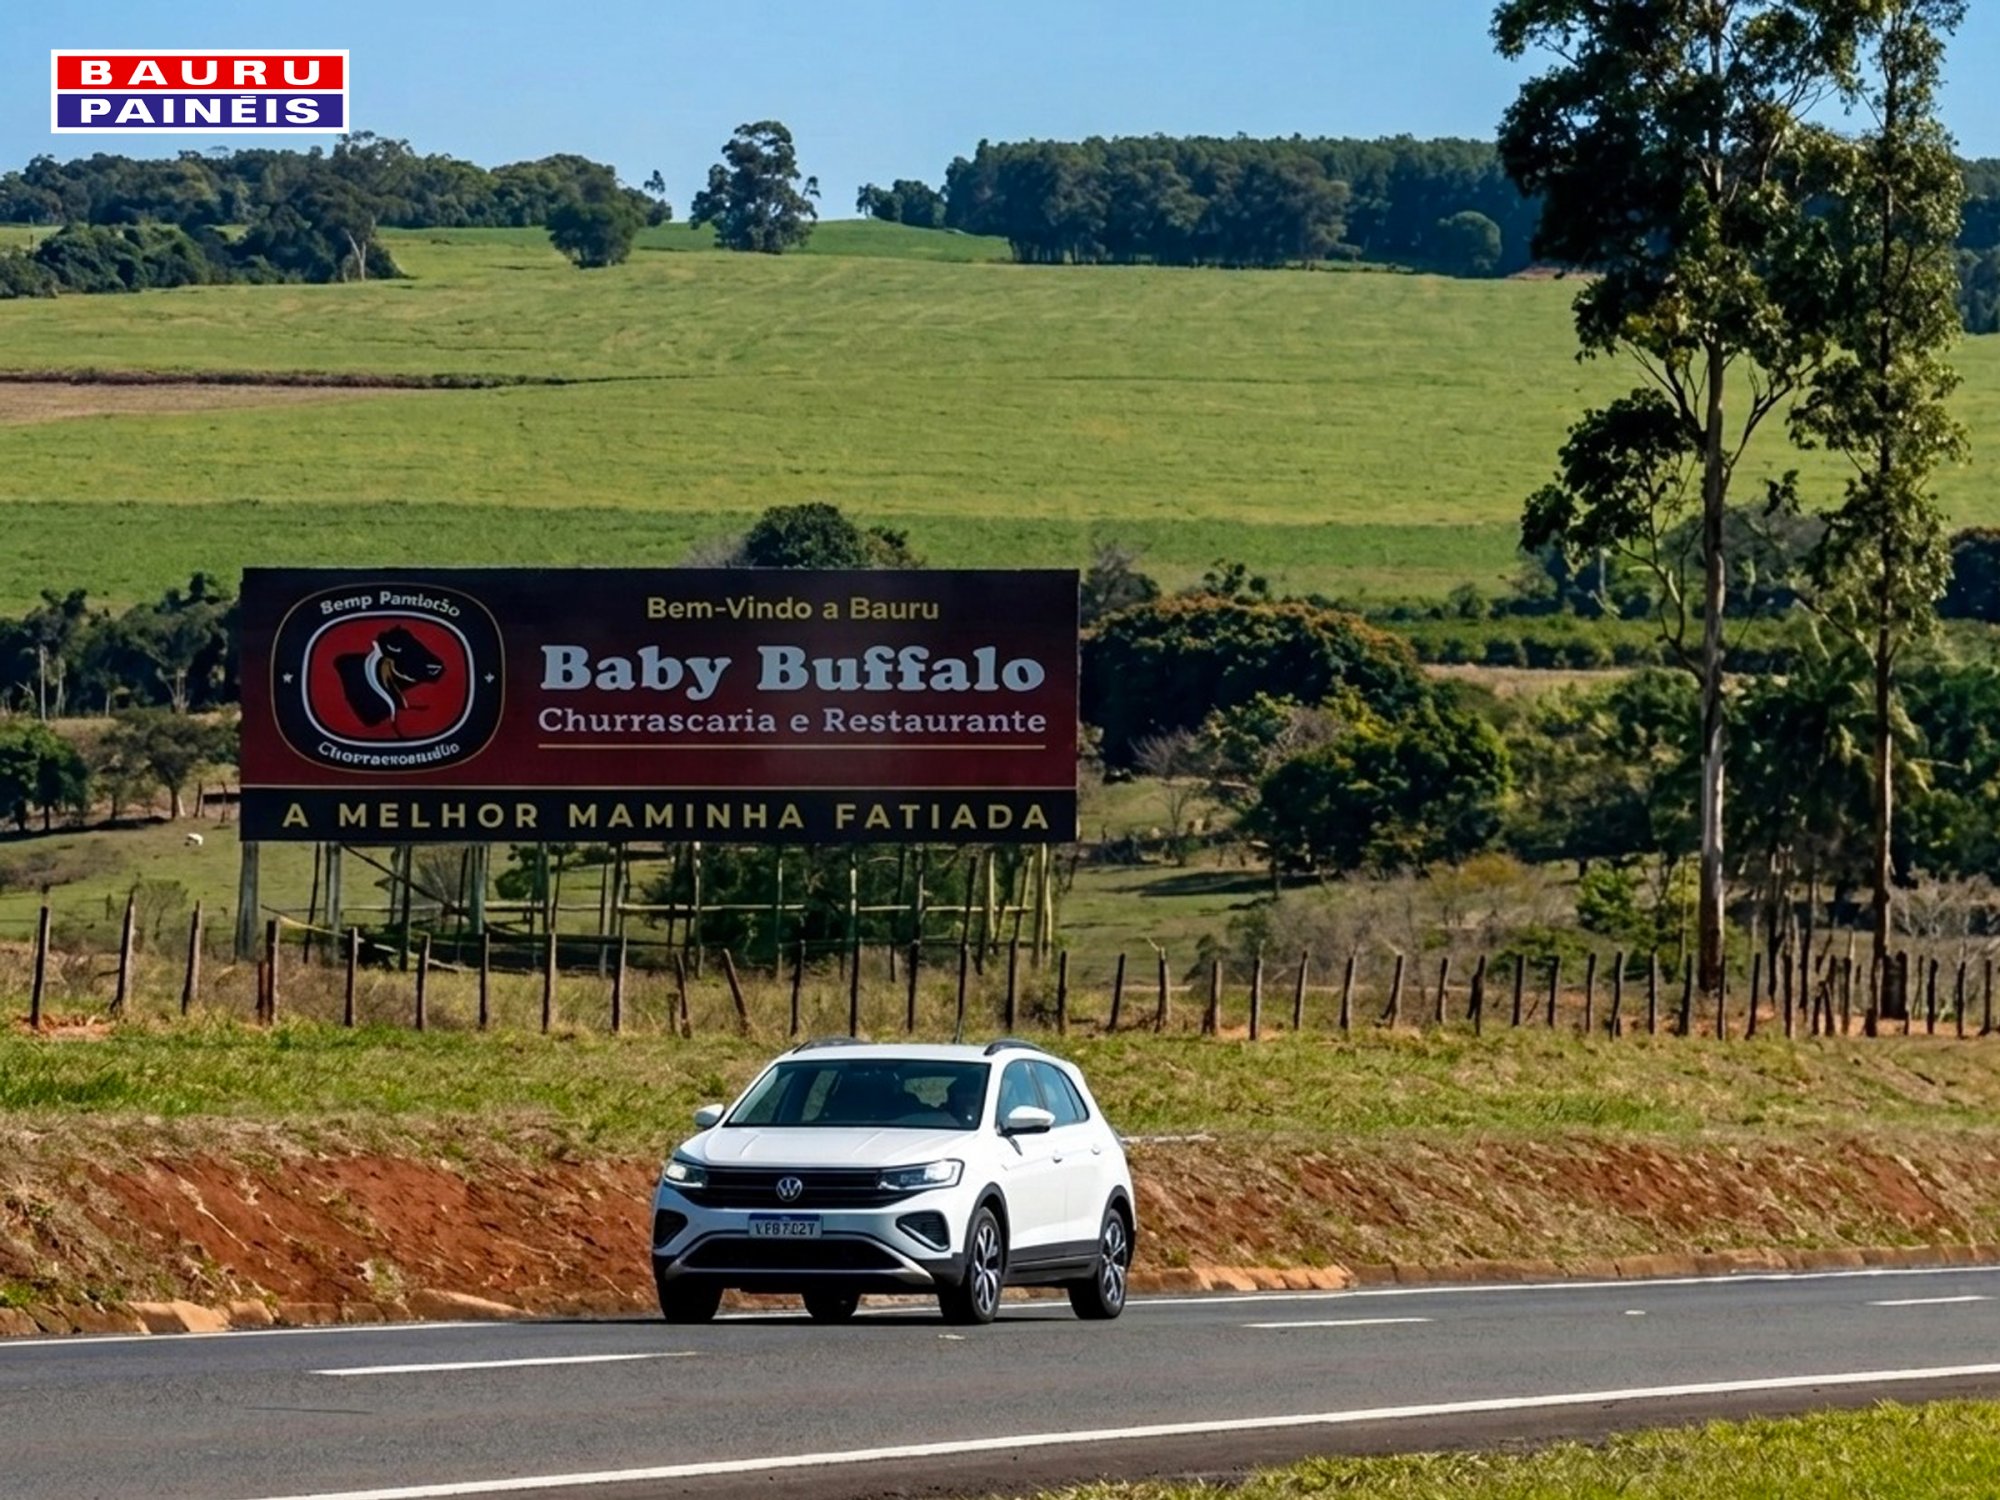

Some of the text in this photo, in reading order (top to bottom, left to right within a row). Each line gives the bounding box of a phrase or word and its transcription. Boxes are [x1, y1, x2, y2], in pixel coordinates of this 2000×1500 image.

[646, 596, 940, 620] Bem-Vindo a Bauru
[540, 644, 1046, 701] Baby Buffalo
[538, 706, 1047, 733] Churrascaria e Restaurante
[282, 803, 1050, 830] A MELHOR MAMINHA FATIADA
